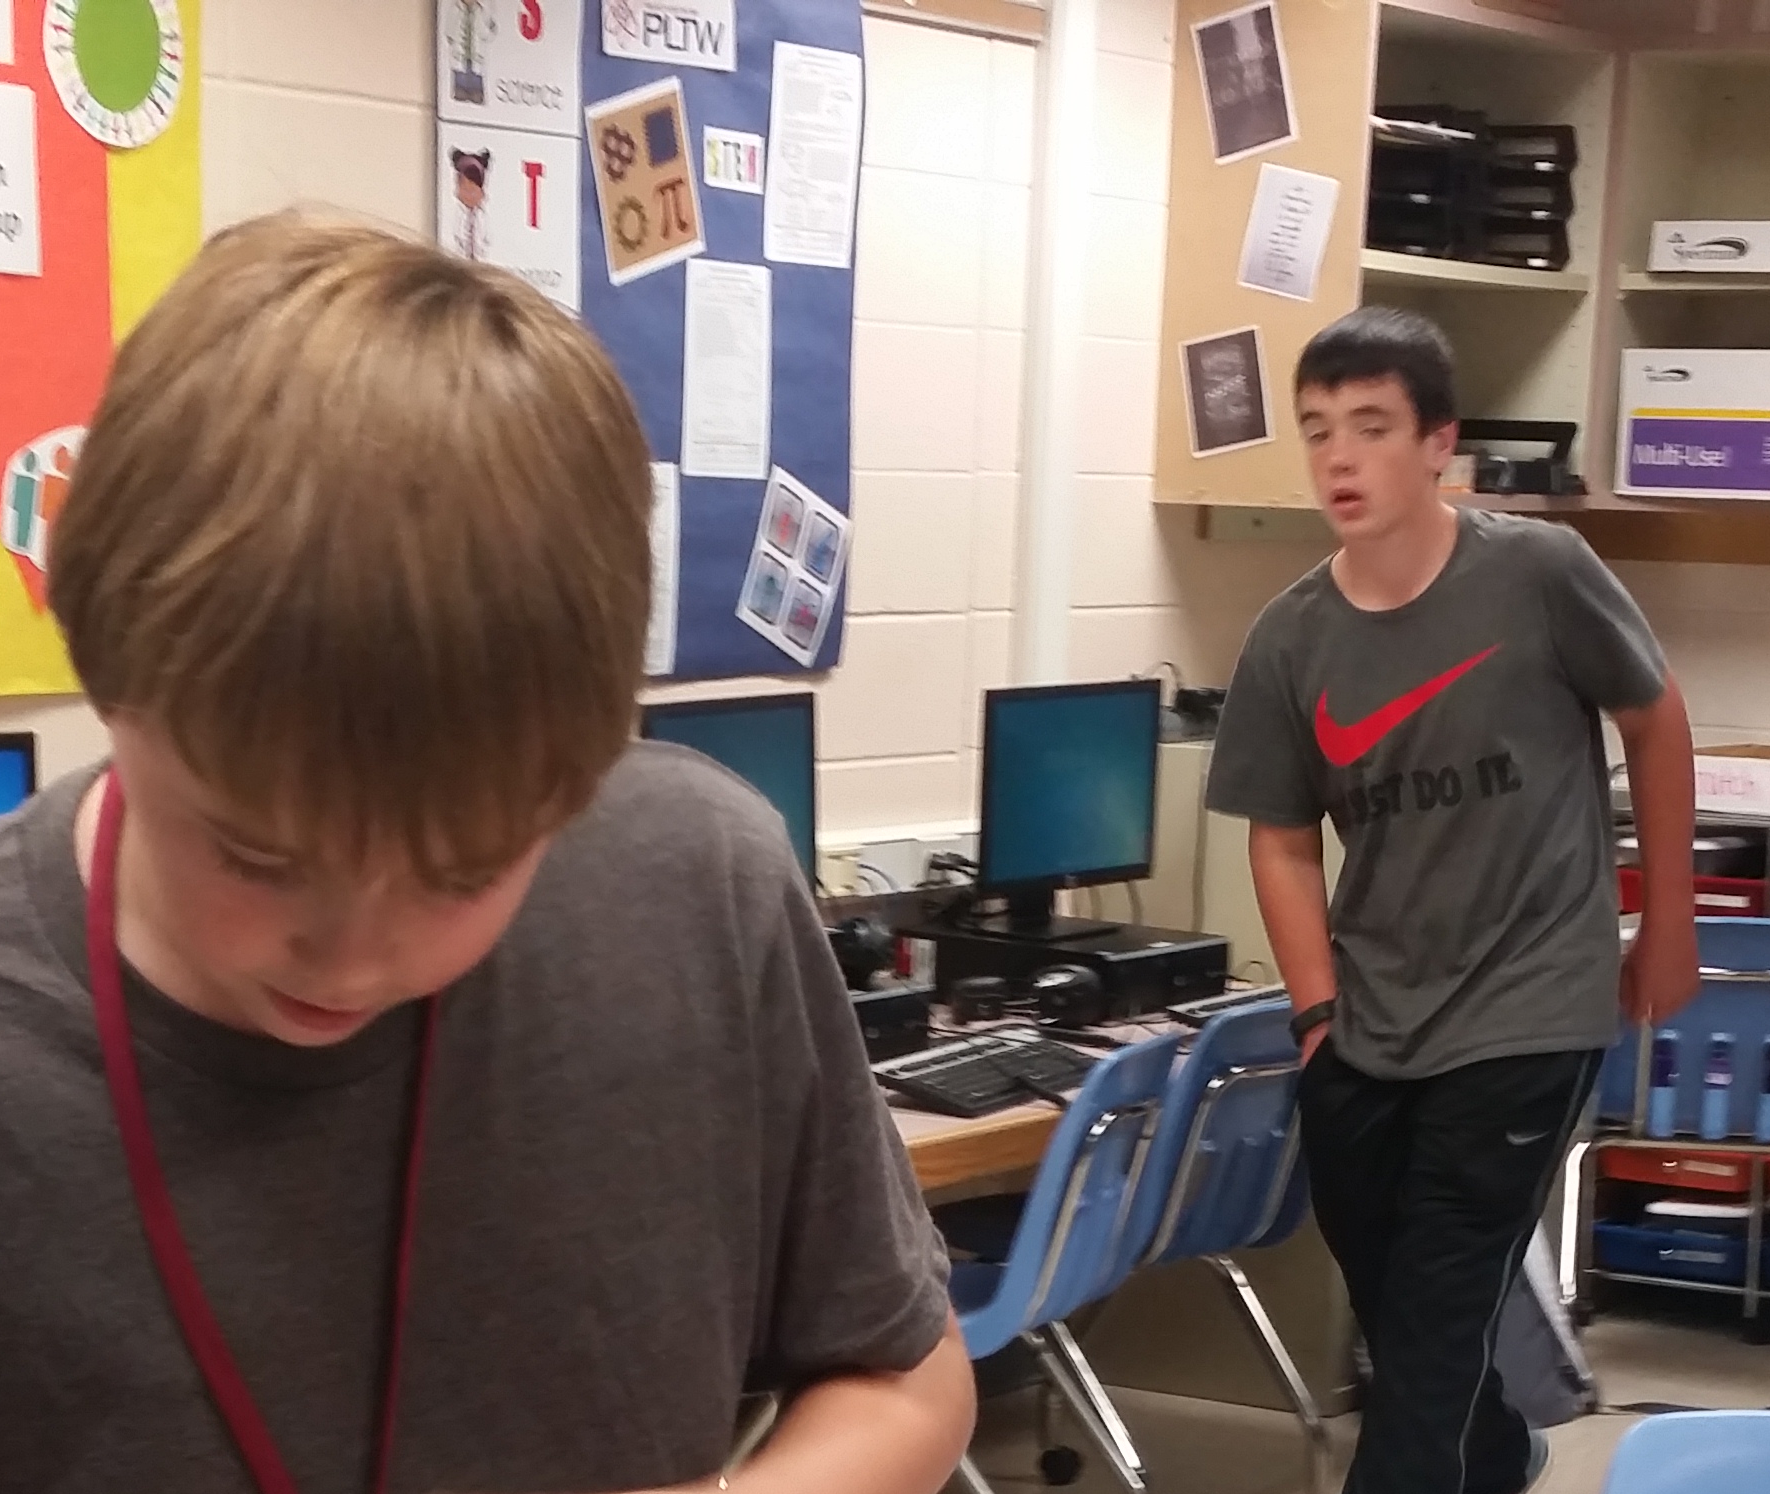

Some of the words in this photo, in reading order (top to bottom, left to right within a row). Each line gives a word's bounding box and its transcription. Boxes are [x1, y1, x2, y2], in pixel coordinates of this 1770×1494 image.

[642, 9, 726, 56] PLTW
[520, 160, 547, 230] T
[1410, 764, 1464, 812] DO
